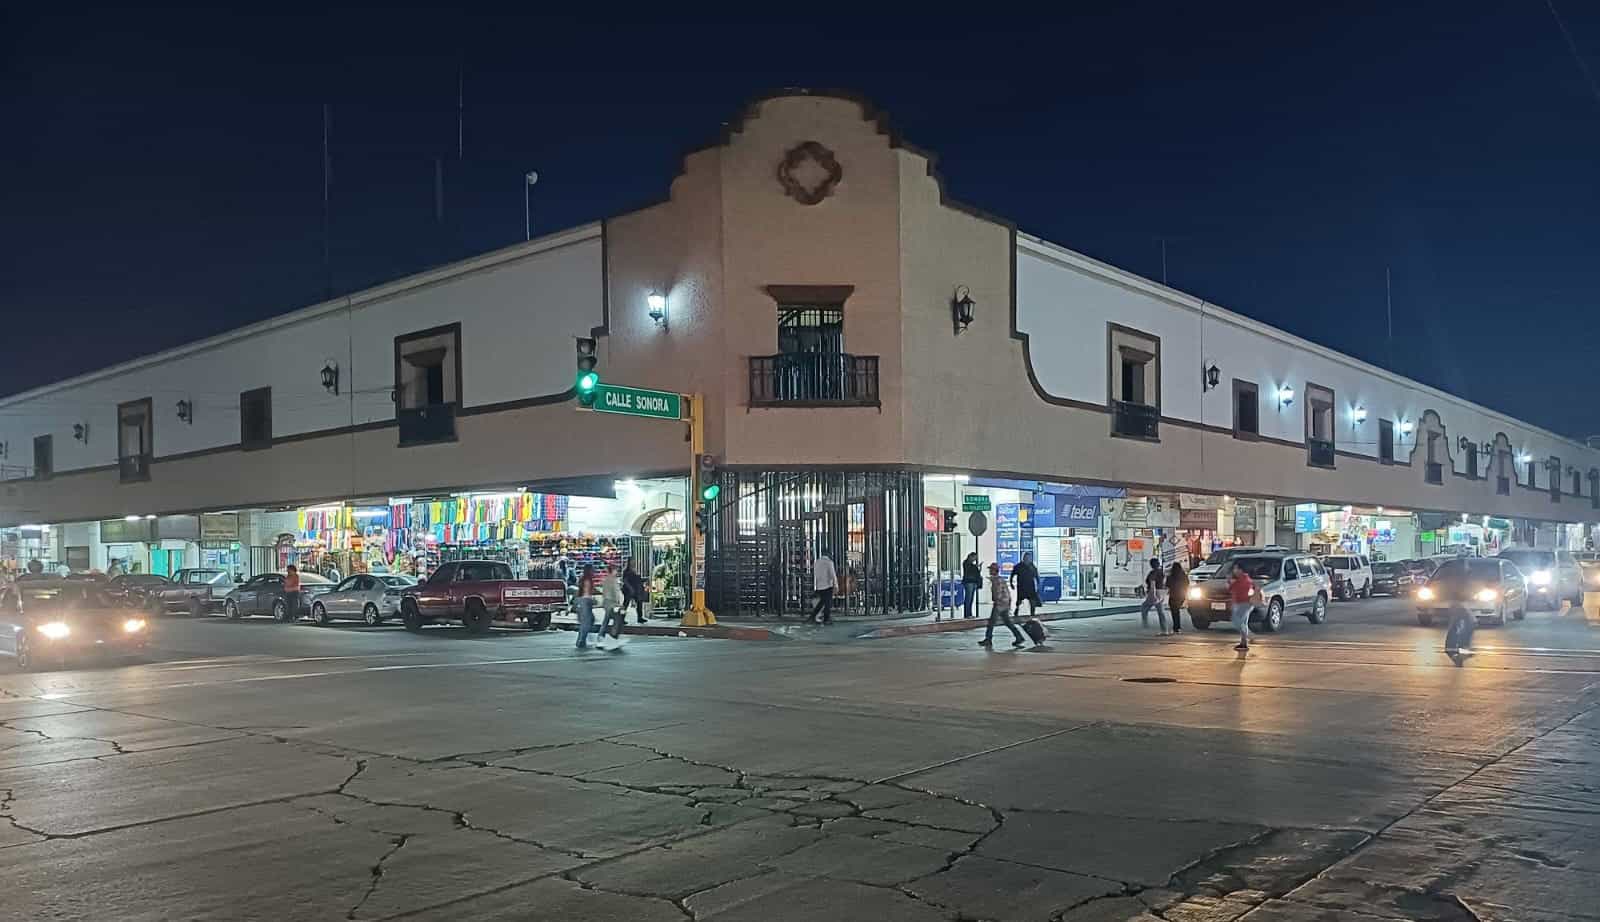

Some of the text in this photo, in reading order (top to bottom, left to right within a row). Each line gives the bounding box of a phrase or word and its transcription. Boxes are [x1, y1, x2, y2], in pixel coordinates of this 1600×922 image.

[606, 392, 669, 412] CALLE SONORA
[1070, 504, 1097, 520] telcel
